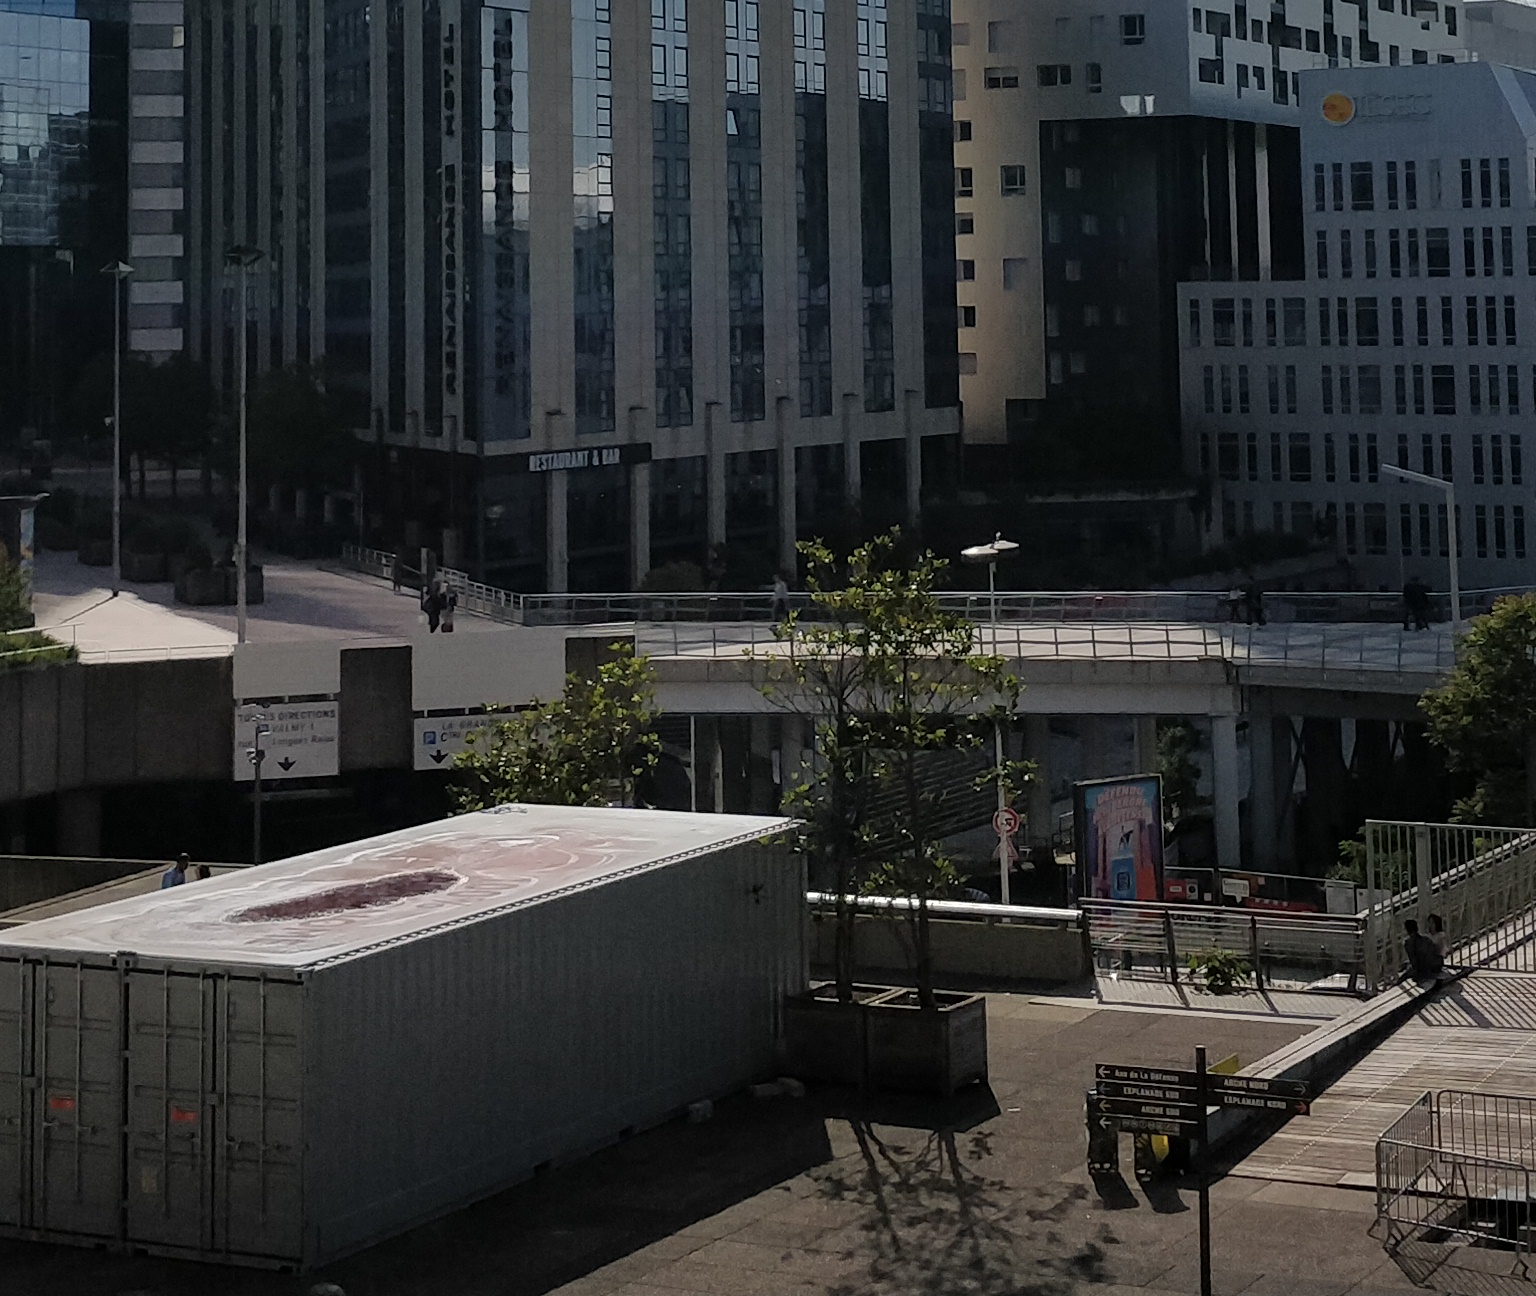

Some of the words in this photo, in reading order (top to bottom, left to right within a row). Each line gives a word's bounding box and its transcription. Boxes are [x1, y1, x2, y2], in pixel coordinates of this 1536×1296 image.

[443, 23, 455, 136] HOTEL
[493, 17, 513, 132] HOTEL
[529, 450, 589, 472] RESTAURANT
[592, 449, 600, 466] &
[602, 448, 620, 465] BAR
[278, 709, 335, 720] DIRECTIONS
